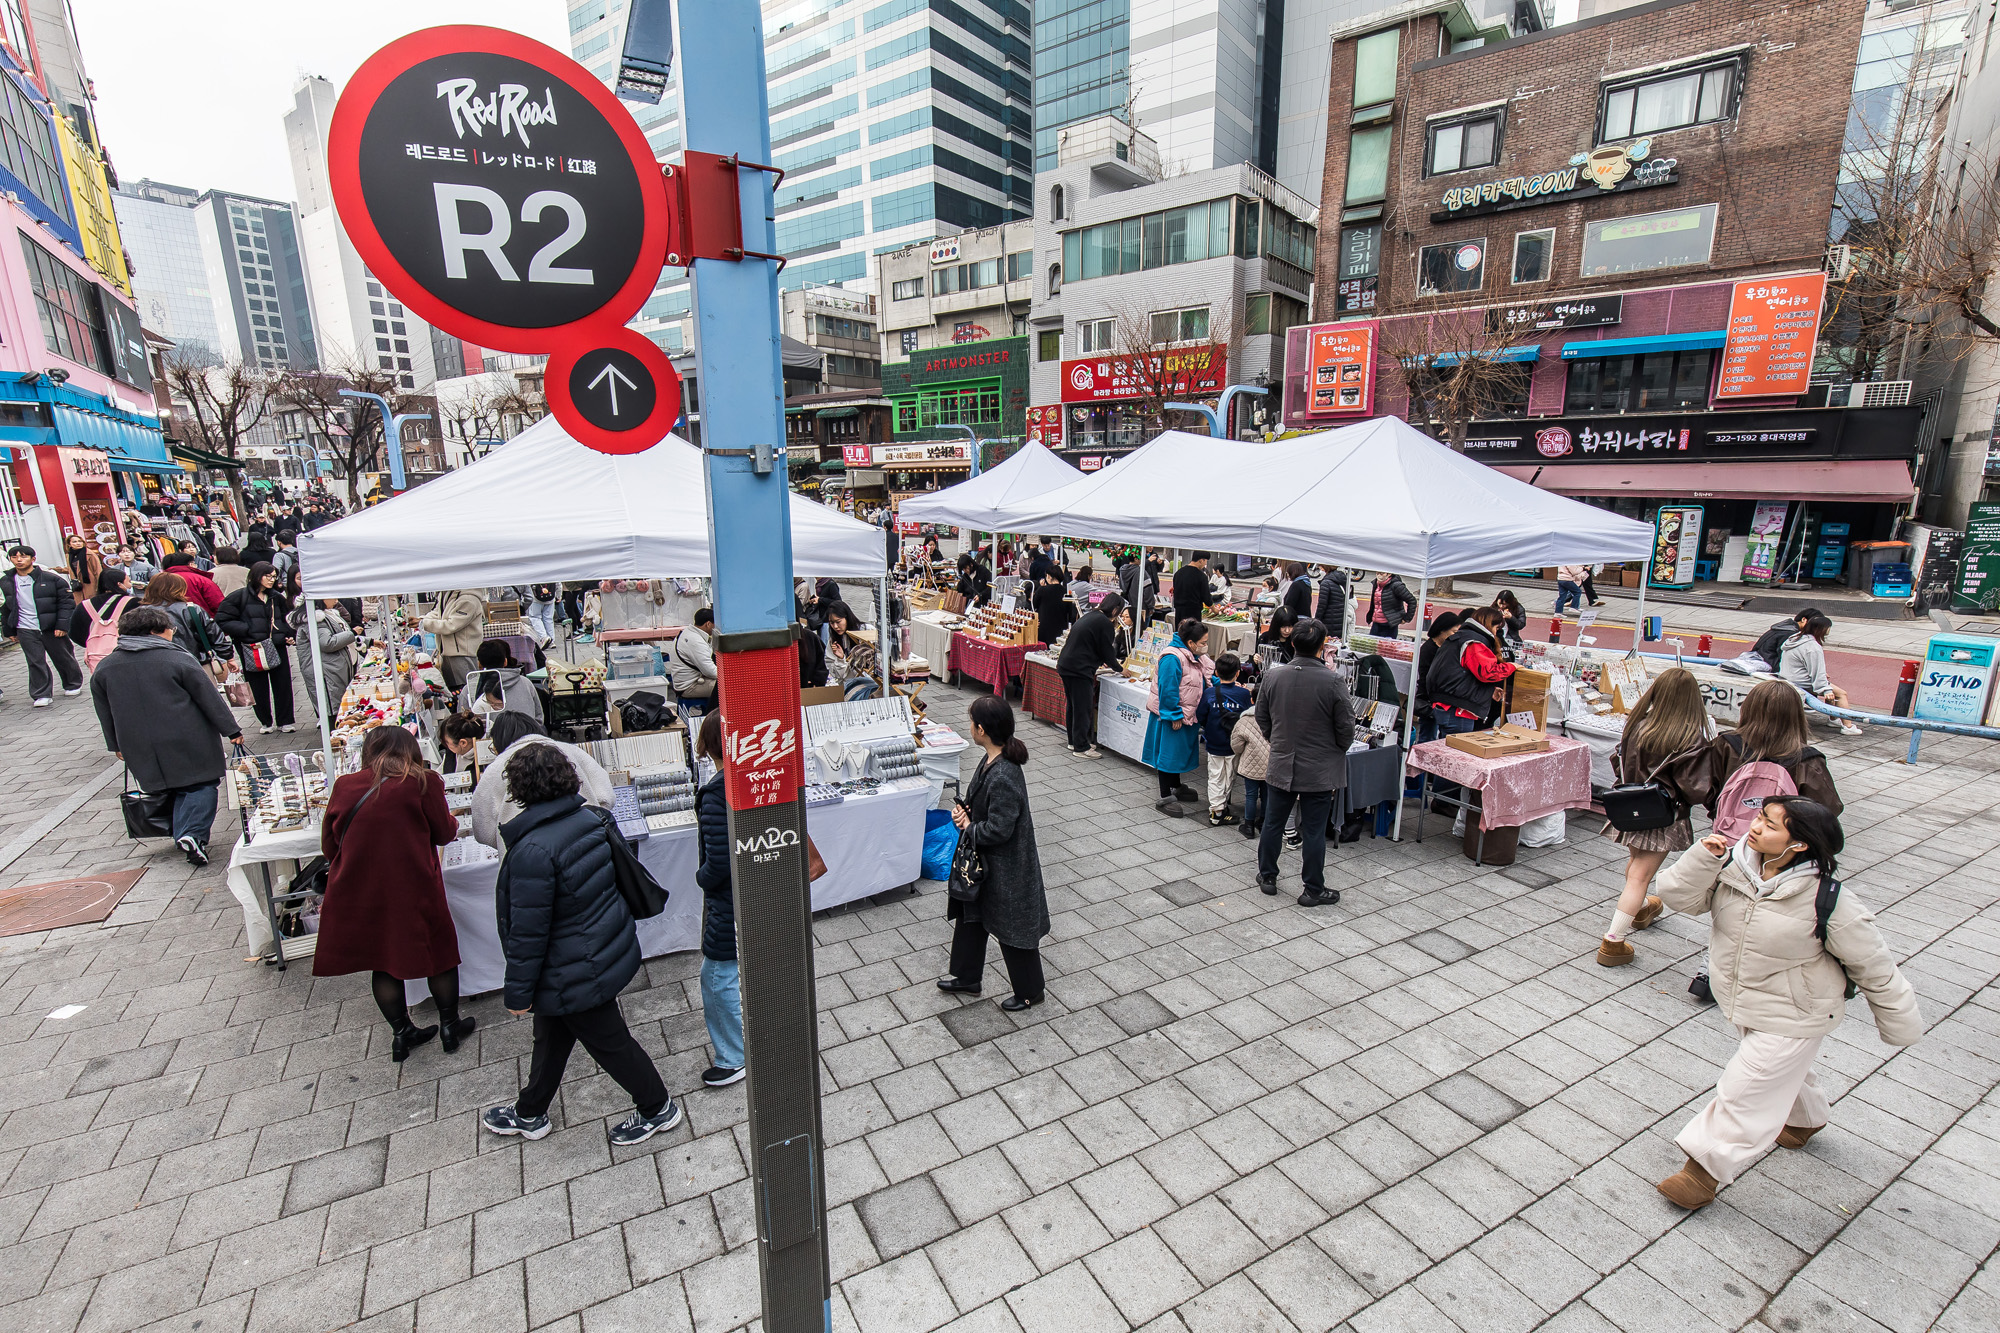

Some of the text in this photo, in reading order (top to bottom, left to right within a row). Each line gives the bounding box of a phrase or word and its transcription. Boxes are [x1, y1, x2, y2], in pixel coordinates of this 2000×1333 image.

[436, 77, 558, 148] Red Road
[405, 143, 469, 163] 레드로드
[567, 158, 597, 175] 红路
[432, 181, 595, 285] R2
[1339, 281, 1360, 294] 성격
[925, 351, 1010, 372] ARTMONSTER
[1715, 432, 1807, 442] 322-1592 홍대직영점
[1920, 671, 1982, 690] STAND
[745, 767, 785, 783] Red Road
[753, 851, 780, 863] 마포구
